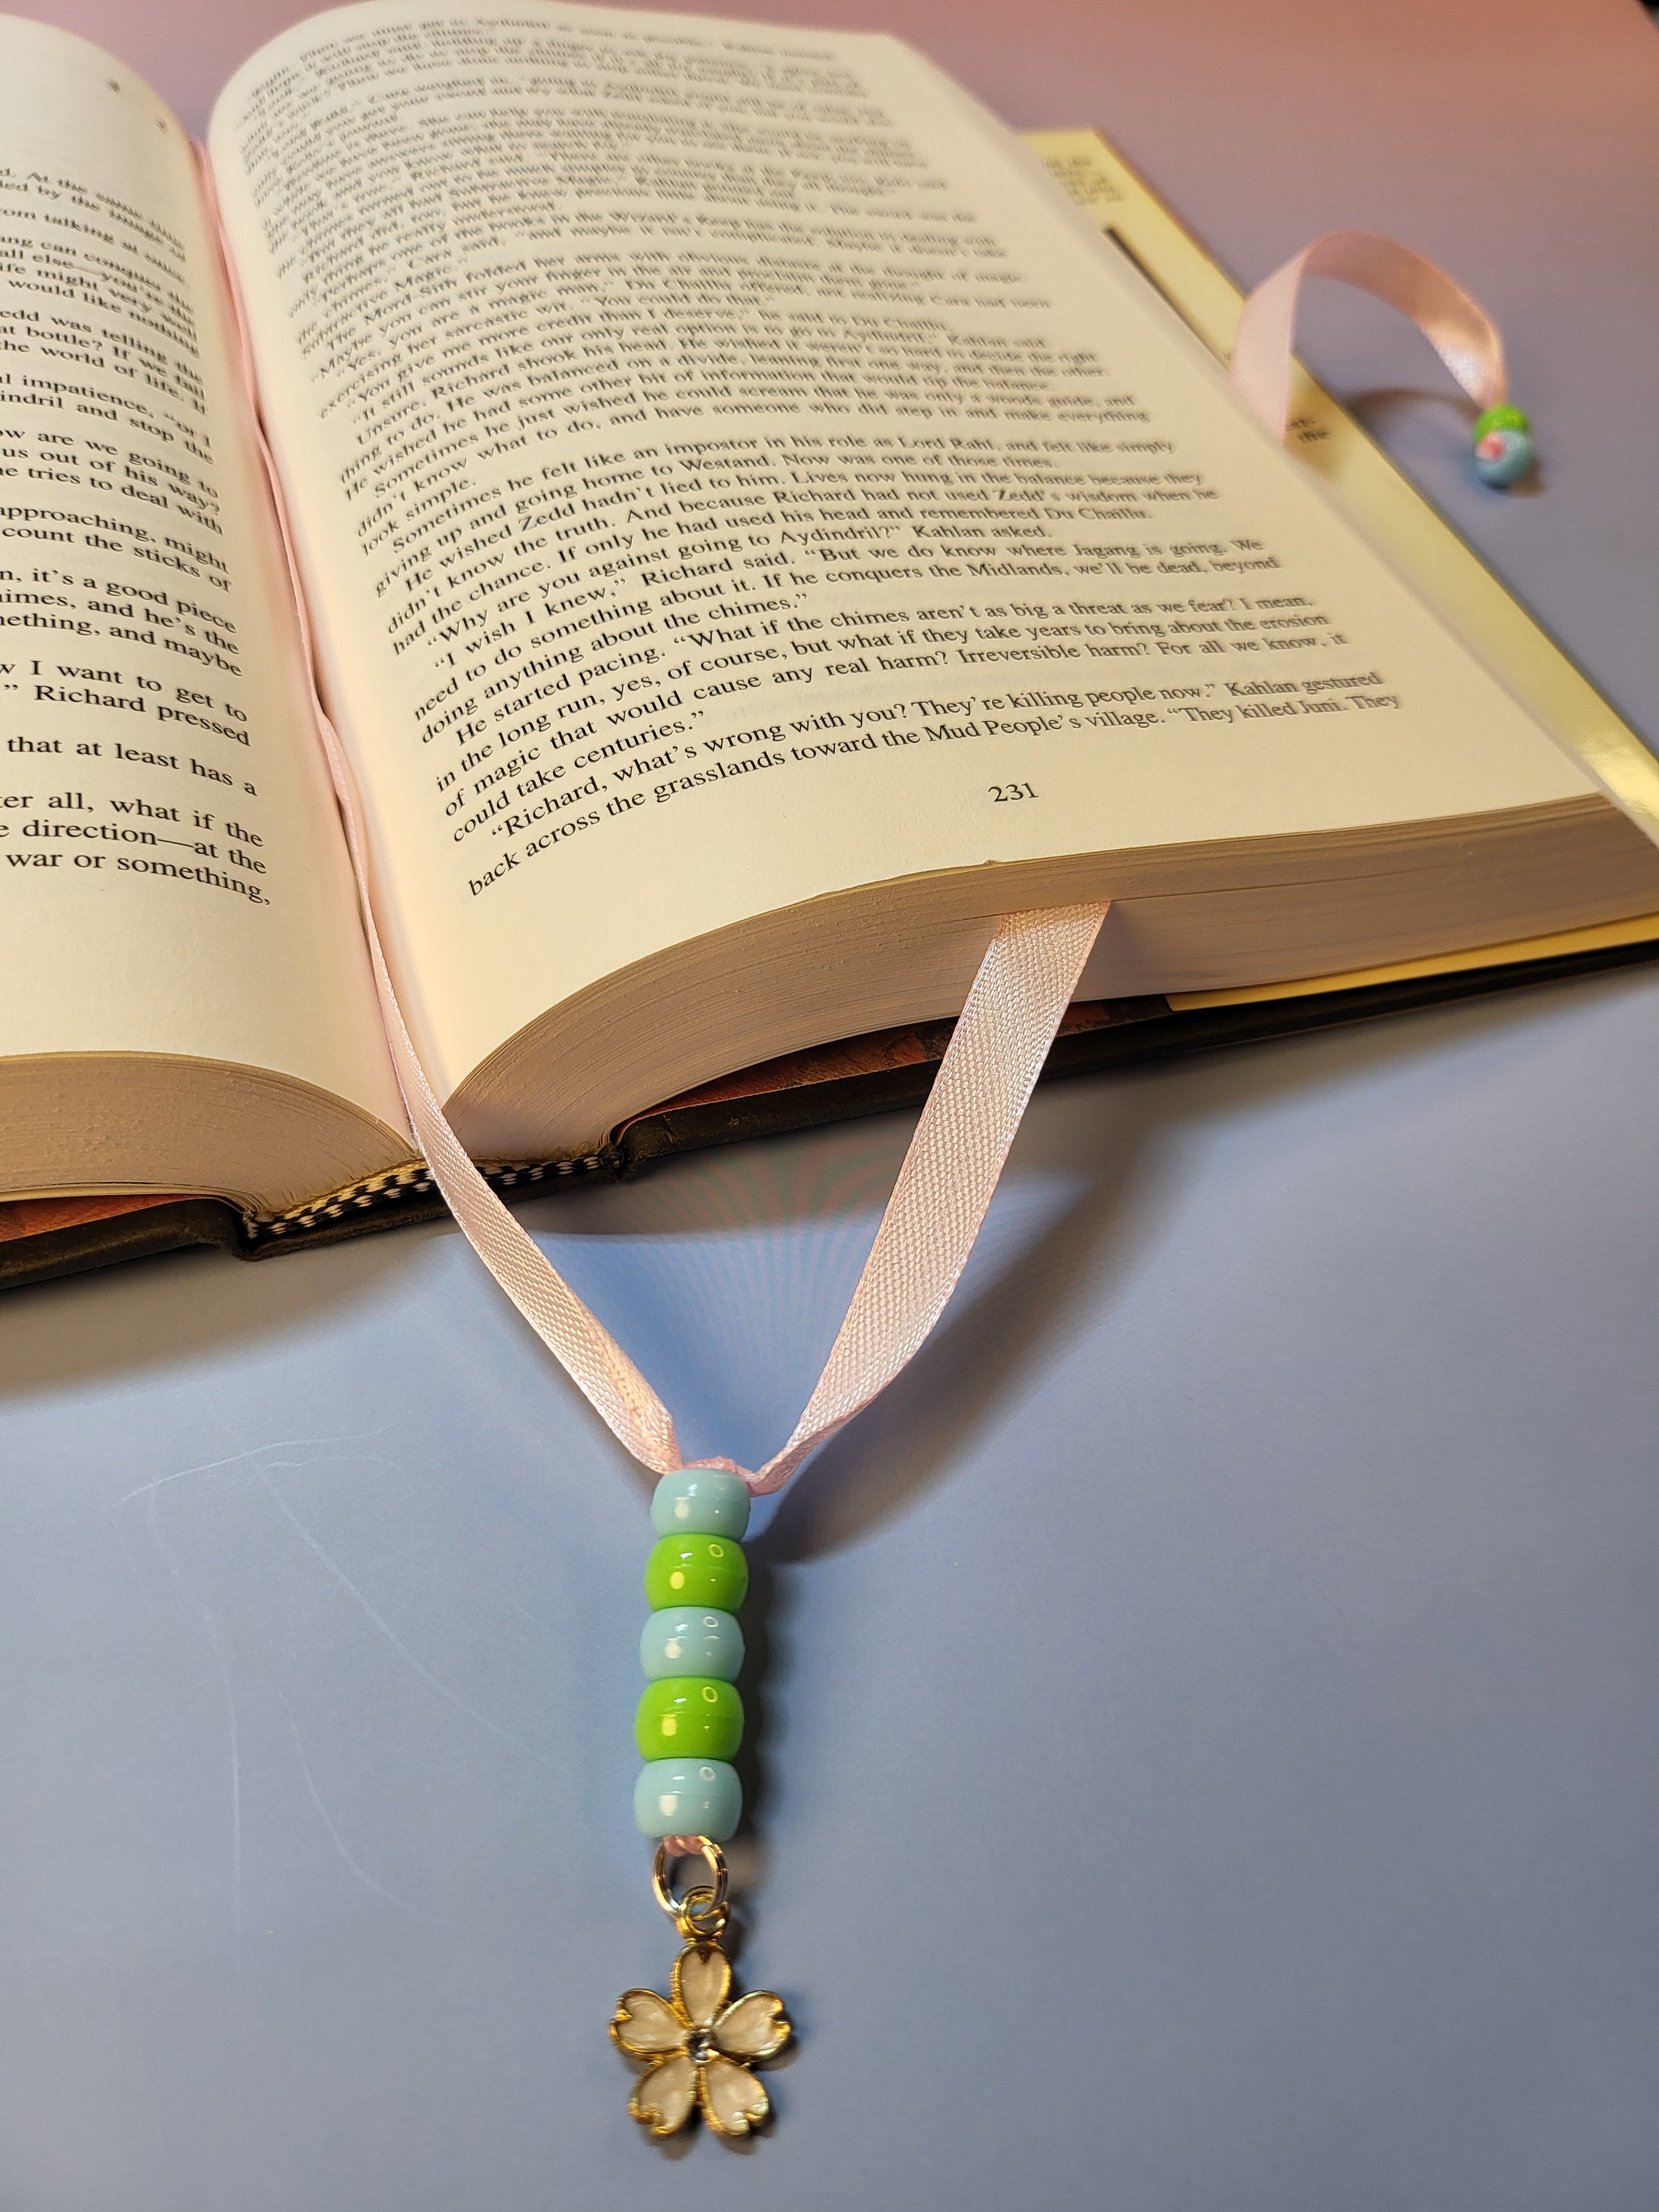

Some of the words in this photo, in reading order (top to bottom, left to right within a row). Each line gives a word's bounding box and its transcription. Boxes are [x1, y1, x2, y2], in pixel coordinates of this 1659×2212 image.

[26, 326, 103, 349] bottle?
[50, 317, 92, 333] was
[101, 328, 167, 364] telling
[22, 375, 154, 419] impatience,
[76, 404, 118, 421] and
[129, 418, 175, 442] stop
[2, 448, 29, 458] us
[39, 452, 79, 466] out
[89, 461, 116, 473] of
[124, 465, 158, 487] his
[167, 483, 221, 513] way?
[37, 432, 74, 446] are
[85, 440, 118, 456] we
[128, 452, 191, 485] going
[198, 481, 219, 499] to
[28, 467, 81, 484] tries
[89, 477, 113, 491] to
[121, 484, 169, 509] deal
[176, 504, 223, 535] with
[1, 528, 74, 544] count
[84, 534, 123, 552] the
[133, 546, 201, 578] sticks
[208, 575, 232, 593] of
[164, 536, 228, 574] might
[427, 609, 488, 646] “Why
[497, 591, 529, 613] are
[538, 572, 581, 599] you
[588, 548, 669, 578] against
[677, 539, 744, 560] going
[747, 535, 771, 546] to
[781, 525, 900, 546] Aydindril?”
[911, 525, 985, 538] Kahlan
[990, 525, 1053, 538] asked.
[32, 567, 74, 585] it’s
[82, 578, 97, 589] a
[106, 582, 169, 606] good
[176, 600, 237, 634] piece
[87, 600, 135, 618] and
[144, 608, 196, 636] he’s
[204, 630, 239, 655] the
[109, 626, 156, 645] and
[163, 639, 243, 677] maybe
[422, 697, 478, 744] doing
[484, 646, 585, 700] anything
[591, 621, 656, 651] about
[663, 613, 701, 630] the
[708, 593, 807, 620] chimes.”
[456, 719, 486, 745] He
[493, 673, 571, 722] started
[578, 648, 666, 687] pacing.
[673, 625, 757, 648] “What
[759, 619, 779, 635] if
[786, 616, 824, 632] the
[830, 611, 910, 628] chimes
[916, 604, 981, 621] aren’t
[984, 607, 1008, 618] as
[1009, 602, 1050, 620] big
[1051, 605, 1066, 615] a
[1067, 601, 1128, 615] threat
[1130, 603, 1153, 614] as
[1156, 603, 1186, 613] we
[1187, 598, 1235, 613] fear?
[1254, 597, 1313, 609] mean,
[30, 660, 41, 676] I
[56, 665, 123, 685] want
[136, 676, 163, 692] to
[175, 687, 214, 709] get
[225, 703, 248, 722] to
[34, 685, 147, 713] Richard
[156, 705, 251, 747] pressed
[436, 771, 457, 792] in
[460, 744, 493, 773] the
[498, 714, 552, 748] long
[556, 695, 606, 719] run,
[611, 676, 661, 702] yes,
[667, 660, 692, 680] of
[700, 648, 787, 672] course,
[790, 639, 833, 655] but
[836, 633, 895, 650] what
[896, 629, 916, 645] if
[921, 628, 968, 645] they
[974, 624, 1022, 640] take
[1024, 625, 1082, 641] years
[1083, 624, 1107, 636] to
[1107, 621, 1166, 638] bring
[1167, 620, 1223, 634] about
[1223, 618, 1256, 632] the
[1259, 614, 1330, 630] erosion
[445, 787, 465, 817] of
[473, 747, 541, 795] magic
[550, 721, 598, 750] that
[606, 690, 684, 726] would
[693, 676, 762, 700] cause
[771, 667, 813, 684] any
[824, 657, 870, 676] real
[875, 650, 948, 671] harm?
[956, 644, 1081, 664] Irreversible
[1083, 641, 1150, 658] harm?
[1154, 641, 1192, 656] For
[1198, 639, 1227, 654] all
[1229, 641, 1260, 652] we
[1261, 637, 1327, 651] know,
[1329, 633, 1349, 645] it
[491, 775, 608, 838] “Richard,
[612, 745, 698, 782] what’s
[702, 725, 786, 753] wrong
[788, 711, 847, 733] with
[849, 703, 907, 729] you?
[910, 696, 1006, 717] They’re
[1005, 691, 1084, 709] killing
[1083, 686, 1156, 708] people
[1223, 680, 1300, 697] Kahlan
[1300, 671, 1384, 696] gestured
[7, 735, 63, 754] that
[76, 742, 103, 757] at
[114, 742, 180, 770] least
[189, 758, 233, 786] has
[243, 782, 258, 797] a
[453, 790, 511, 843] could
[516, 765, 566, 797] take
[573, 710, 704, 769] centuries.”
[467, 852, 521, 896] back
[525, 810, 601, 858] across
[605, 792, 646, 817] the
[653, 750, 786, 804] grasslands
[790, 733, 879, 761] toward
[880, 730, 921, 747] the
[922, 721, 982, 742] Mud
[980, 714, 1082, 737] People’s
[1083, 711, 1166, 729] village.
[1234, 701, 1299, 719] killed
[1297, 697, 1349, 714] Juni.
[1344, 695, 1400, 710] They
[987, 782, 1040, 803] 231
[22, 818, 220, 859] direction—at
[228, 848, 268, 875] the
[48, 791, 94, 812] all,
[109, 798, 181, 822] what
[192, 810, 216, 831] if
[225, 822, 264, 848] the
[5, 853, 64, 868] war
[73, 854, 107, 869] or
[117, 857, 271, 906] something,
